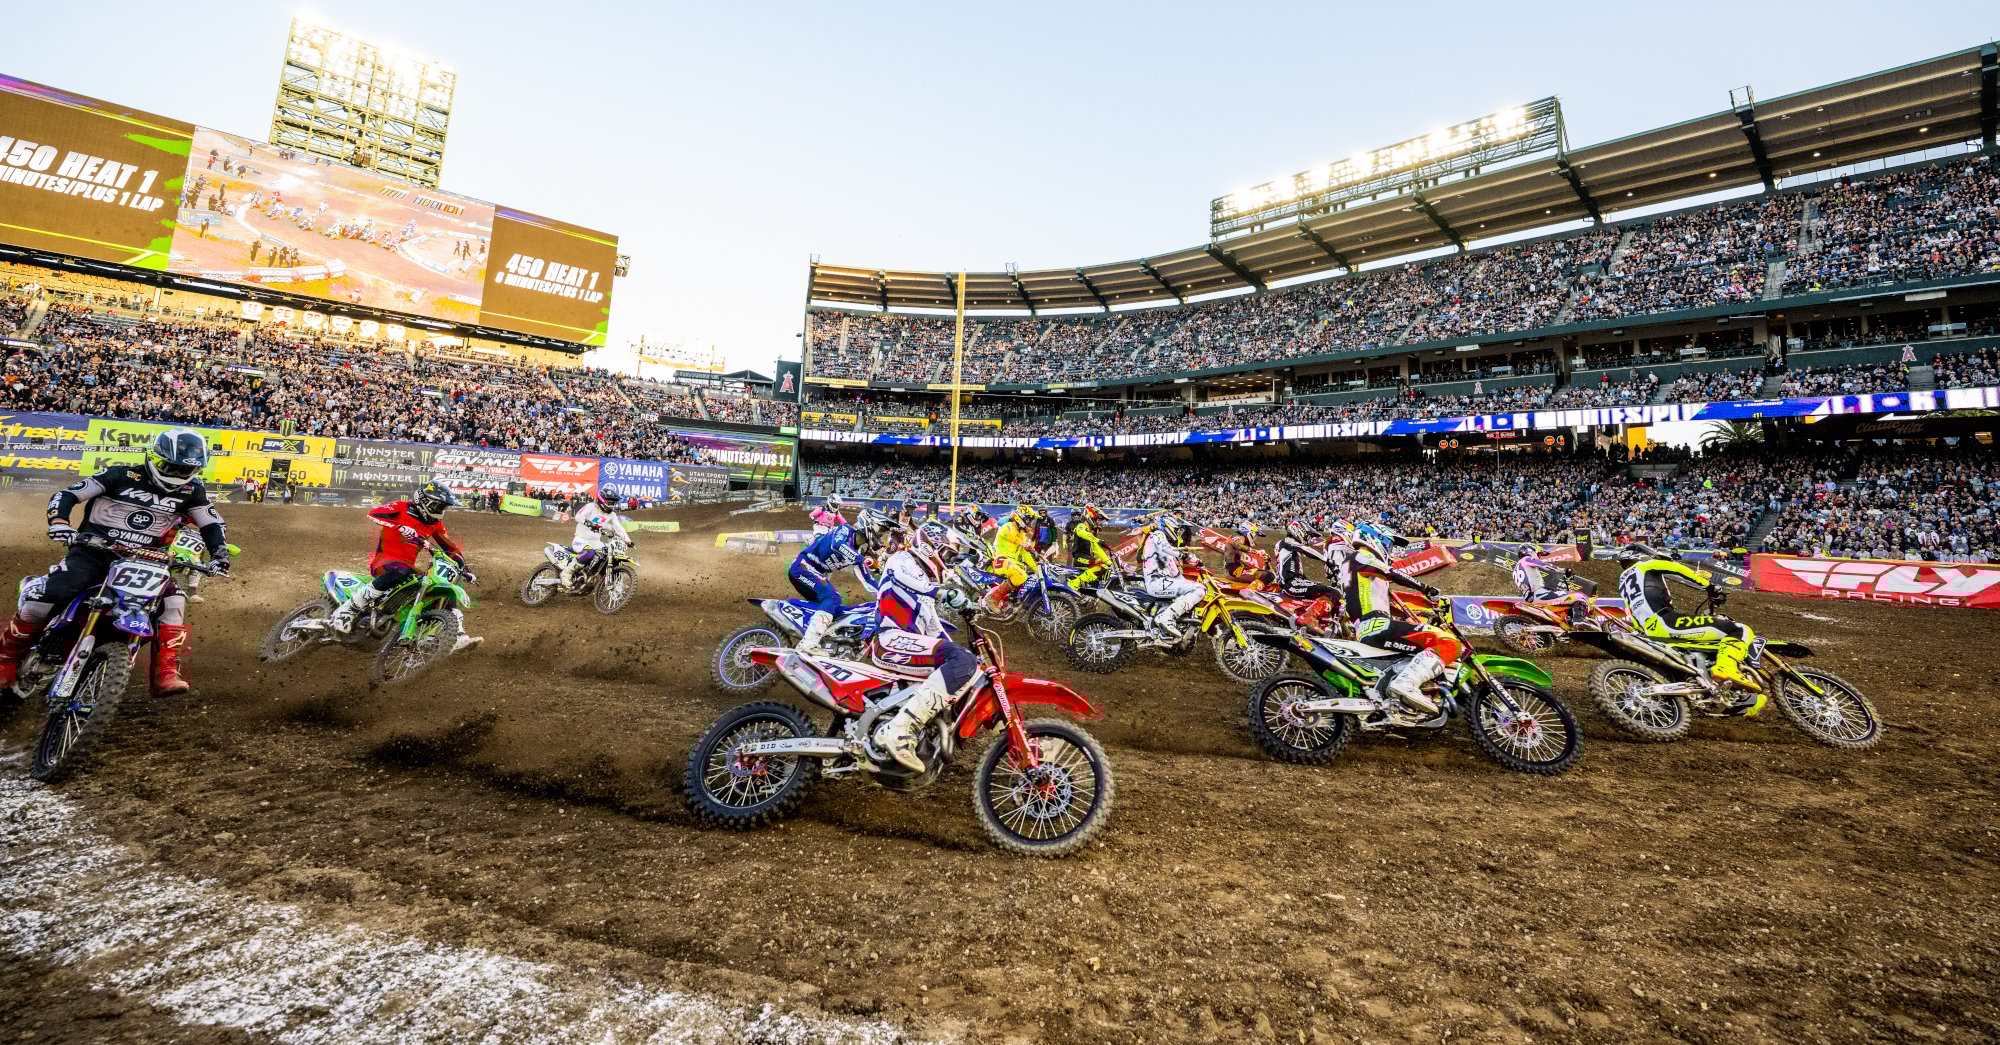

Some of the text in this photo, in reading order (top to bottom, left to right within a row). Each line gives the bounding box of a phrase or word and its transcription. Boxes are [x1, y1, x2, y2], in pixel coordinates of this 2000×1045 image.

[0, 135, 158, 193] 450 HEAT 1
[120, 190, 131, 206] 1
[130, 194, 164, 212] LAP
[505, 253, 600, 290] 450 HEAT 1
[505, 273, 578, 300] MINUTES/PLUS
[577, 285, 585, 300] 1
[584, 288, 603, 303] LAP
[450, 449, 521, 460] ROCKY MOUNTAIN
[526, 458, 597, 472] FLY
[618, 463, 663, 478] YAMAHA
[353, 472, 414, 483] MONSTER
[689, 476, 728, 485] COMMISSION
[706, 472, 728, 480] SPORTS
[617, 484, 662, 498] YAMAHA
[509, 501, 538, 510] Kawasaki
[177, 536, 205, 553] 976
[112, 567, 169, 592] 637
[1772, 559, 2000, 597] FLY
[1821, 589, 1960, 606] RACING
[782, 605, 803, 620] 64
